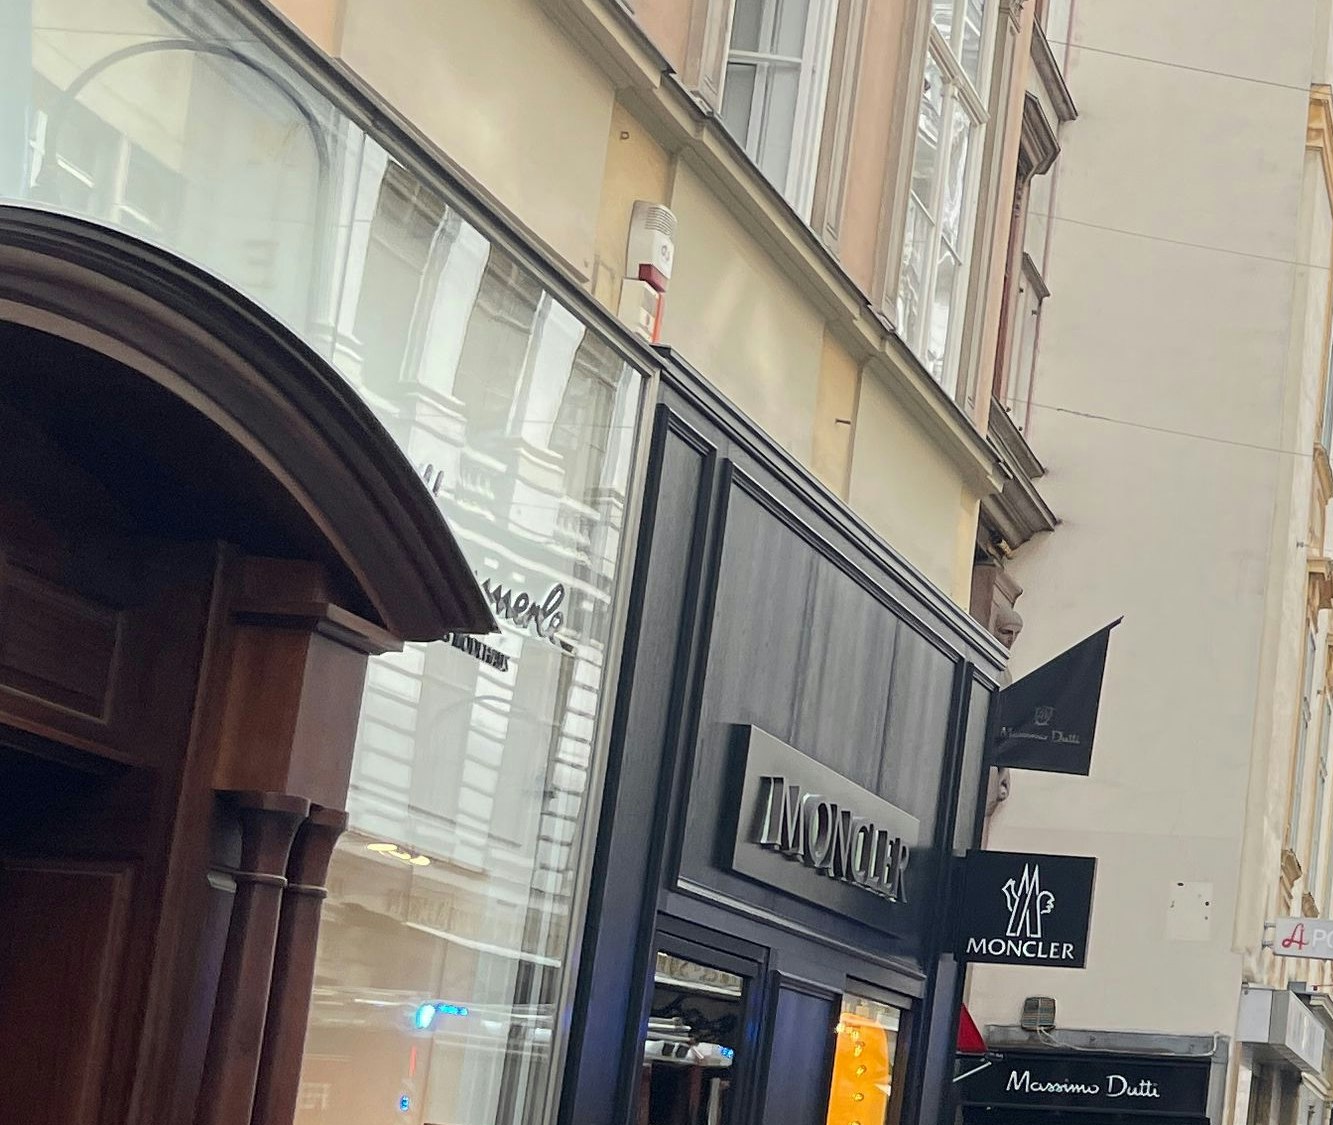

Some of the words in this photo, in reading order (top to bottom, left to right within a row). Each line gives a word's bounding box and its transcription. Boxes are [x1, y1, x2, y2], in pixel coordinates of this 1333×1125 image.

[758, 776, 910, 903] MONCLER
[966, 937, 1075, 960] MONCLER
[1006, 1070, 1100, 1095] Massimo
[1106, 1074, 1160, 1098] Dutti
